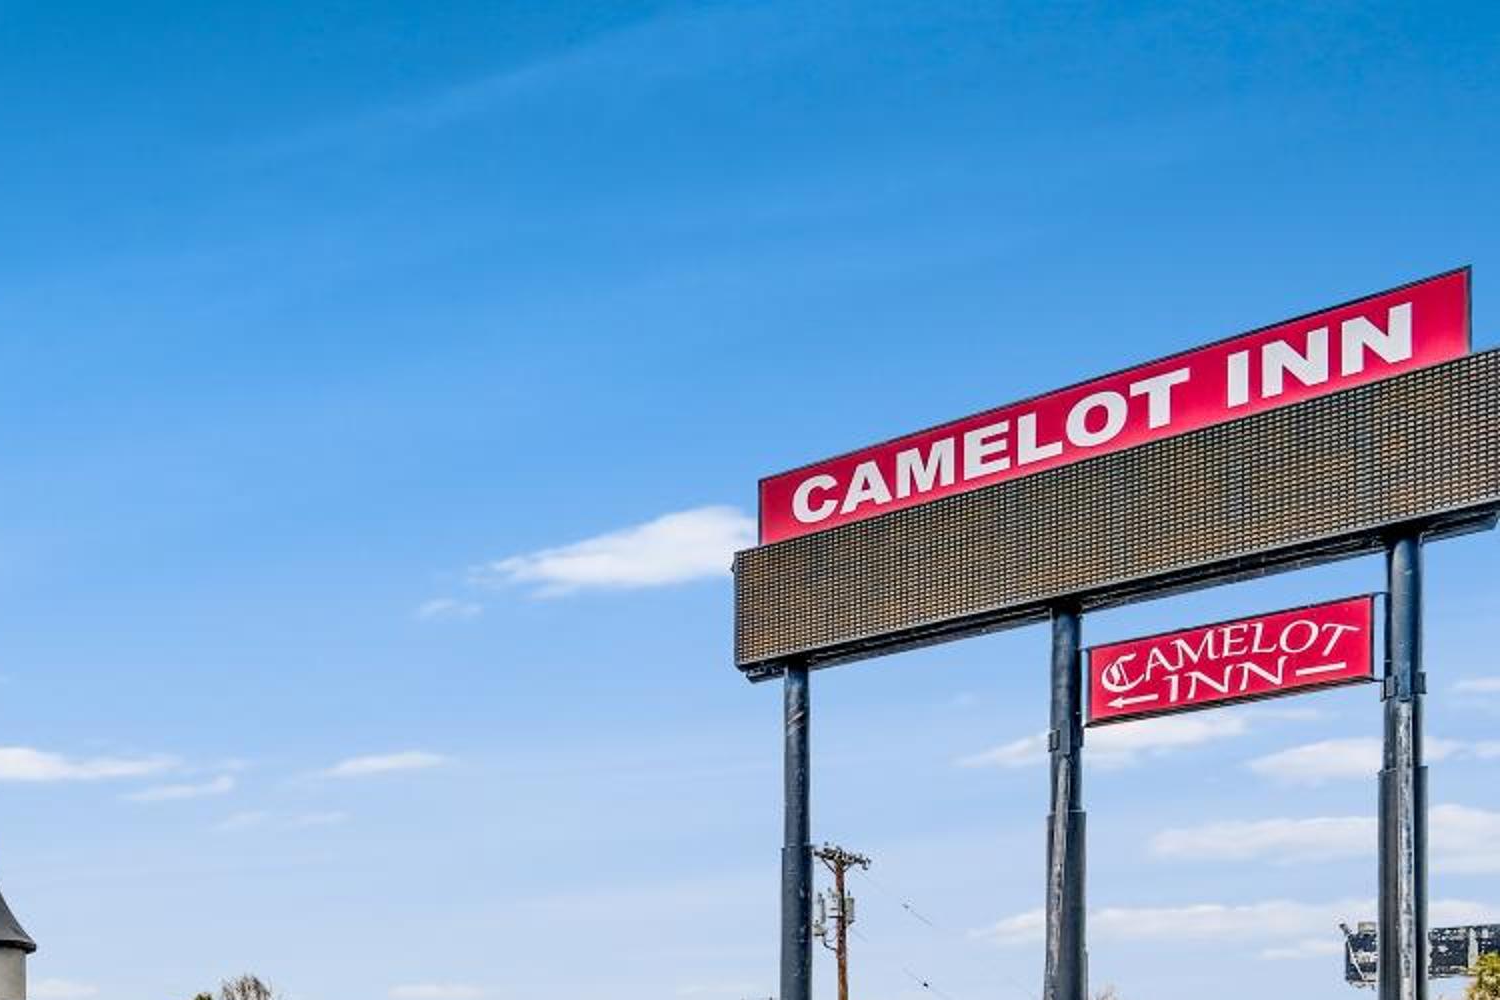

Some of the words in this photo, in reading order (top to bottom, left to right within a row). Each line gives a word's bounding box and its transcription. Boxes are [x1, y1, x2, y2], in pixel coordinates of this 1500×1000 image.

[792, 367, 1190, 523] CAMELOT
[1227, 302, 1413, 409] INN
[1102, 619, 1360, 692] CAMELOT
[1162, 655, 1288, 703] INN
